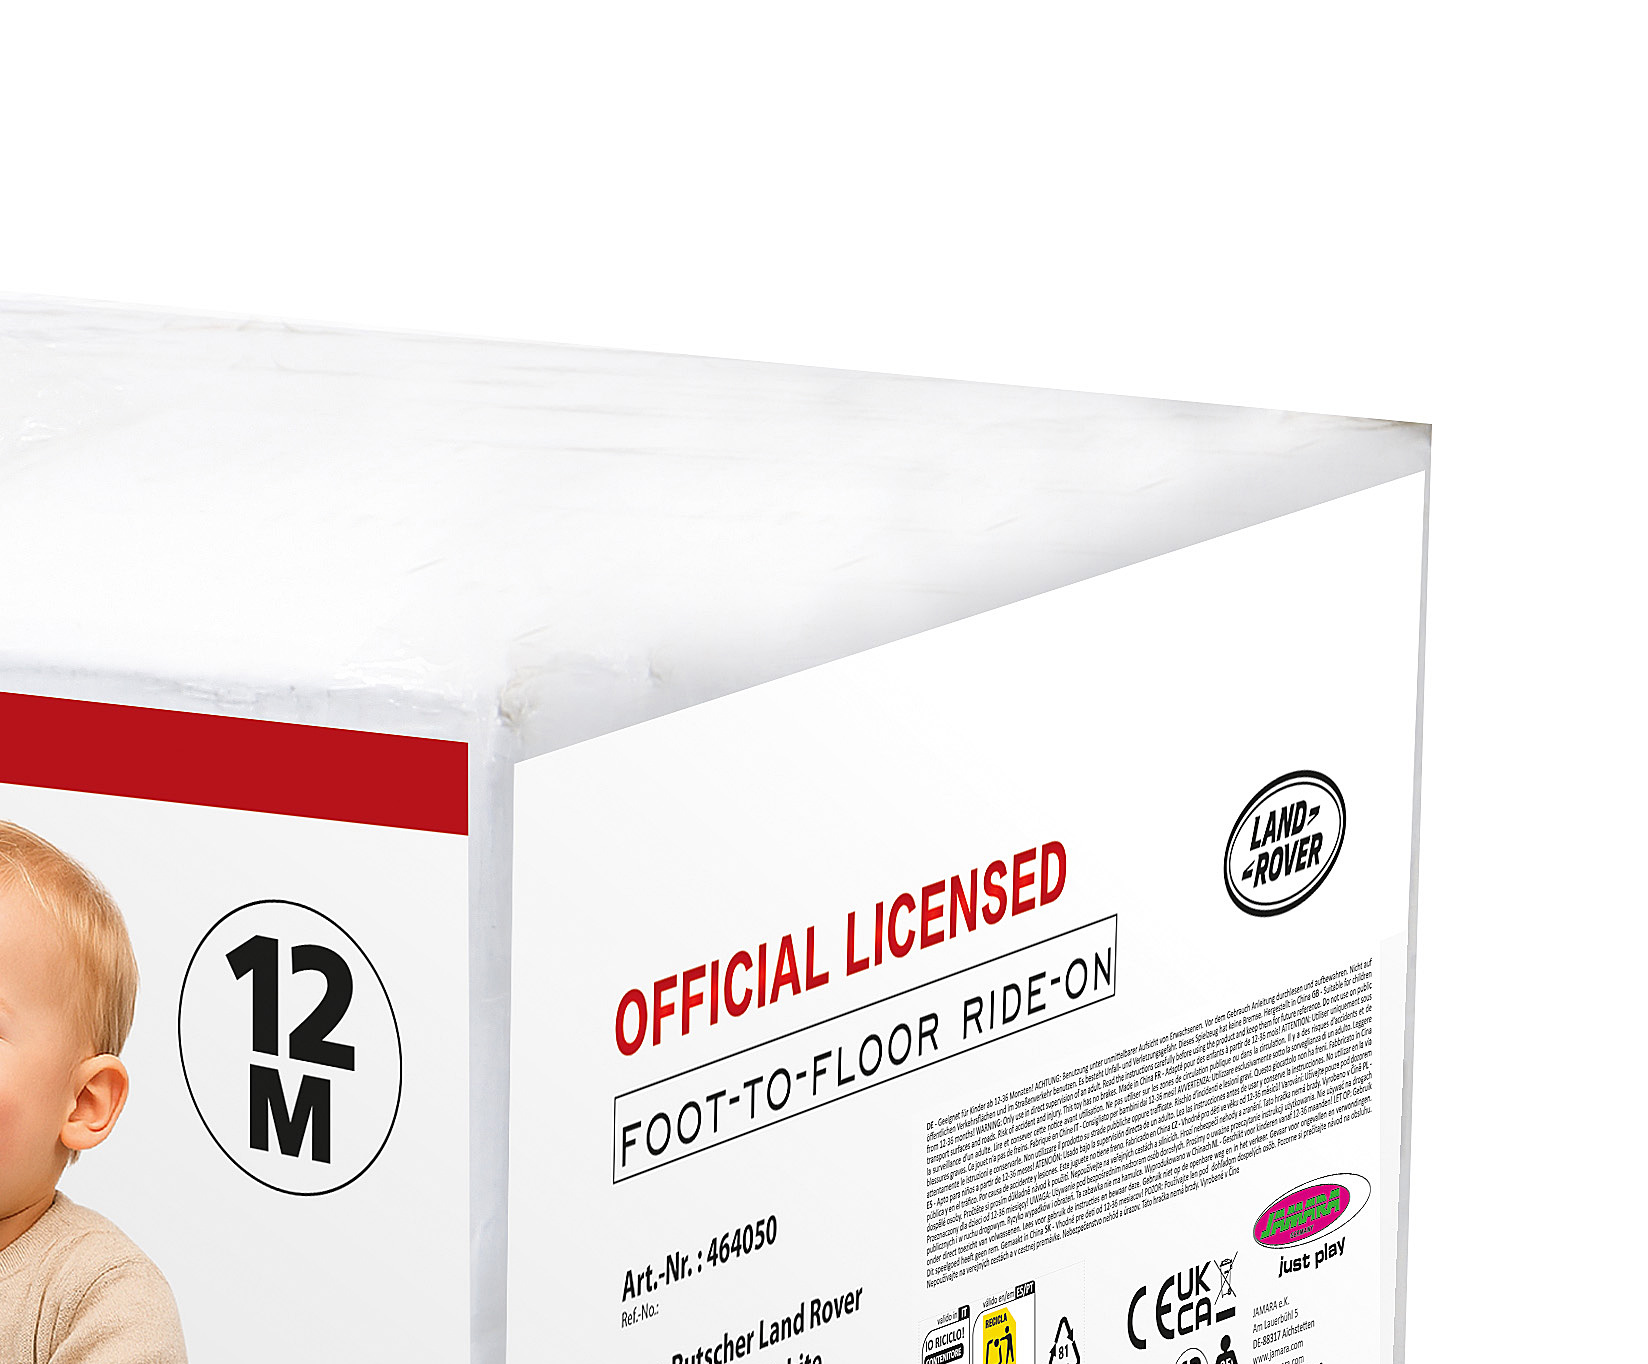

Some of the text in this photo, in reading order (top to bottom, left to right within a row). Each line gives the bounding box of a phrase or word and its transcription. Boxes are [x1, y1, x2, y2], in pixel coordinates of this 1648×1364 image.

[1249, 800, 1308, 850] LAND
[1253, 833, 1324, 887] ROVER
[615, 841, 1066, 1056] OFFICIAL LICENSED
[225, 935, 355, 1071] 12
[622, 947, 1111, 1167] FOOT-TO-FLOOR RIDE-ON
[250, 1063, 330, 1164] M
[1261, 1188, 1340, 1240] JAMARA
[622, 1215, 777, 1302] Art.-Nr. 464050
[1278, 1237, 1346, 1278] just play
[1017, 1282, 1034, 1297] ES/PT
[1178, 1261, 1211, 1300] UK
[622, 1303, 658, 1328] Ref.-No.:
[759, 1302, 804, 1349] Land
[810, 1287, 862, 1329] Rover
[961, 1307, 967, 1317] IT
[985, 1313, 1007, 1329] RECICLA
[1178, 1297, 1211, 1335] CA
[1253, 1297, 1289, 1318] JAMARA e.K.
[935, 1326, 965, 1348] RICICLO!
[1058, 1345, 1069, 1360] 81
[1253, 1339, 1304, 1364] www.jamara.com
